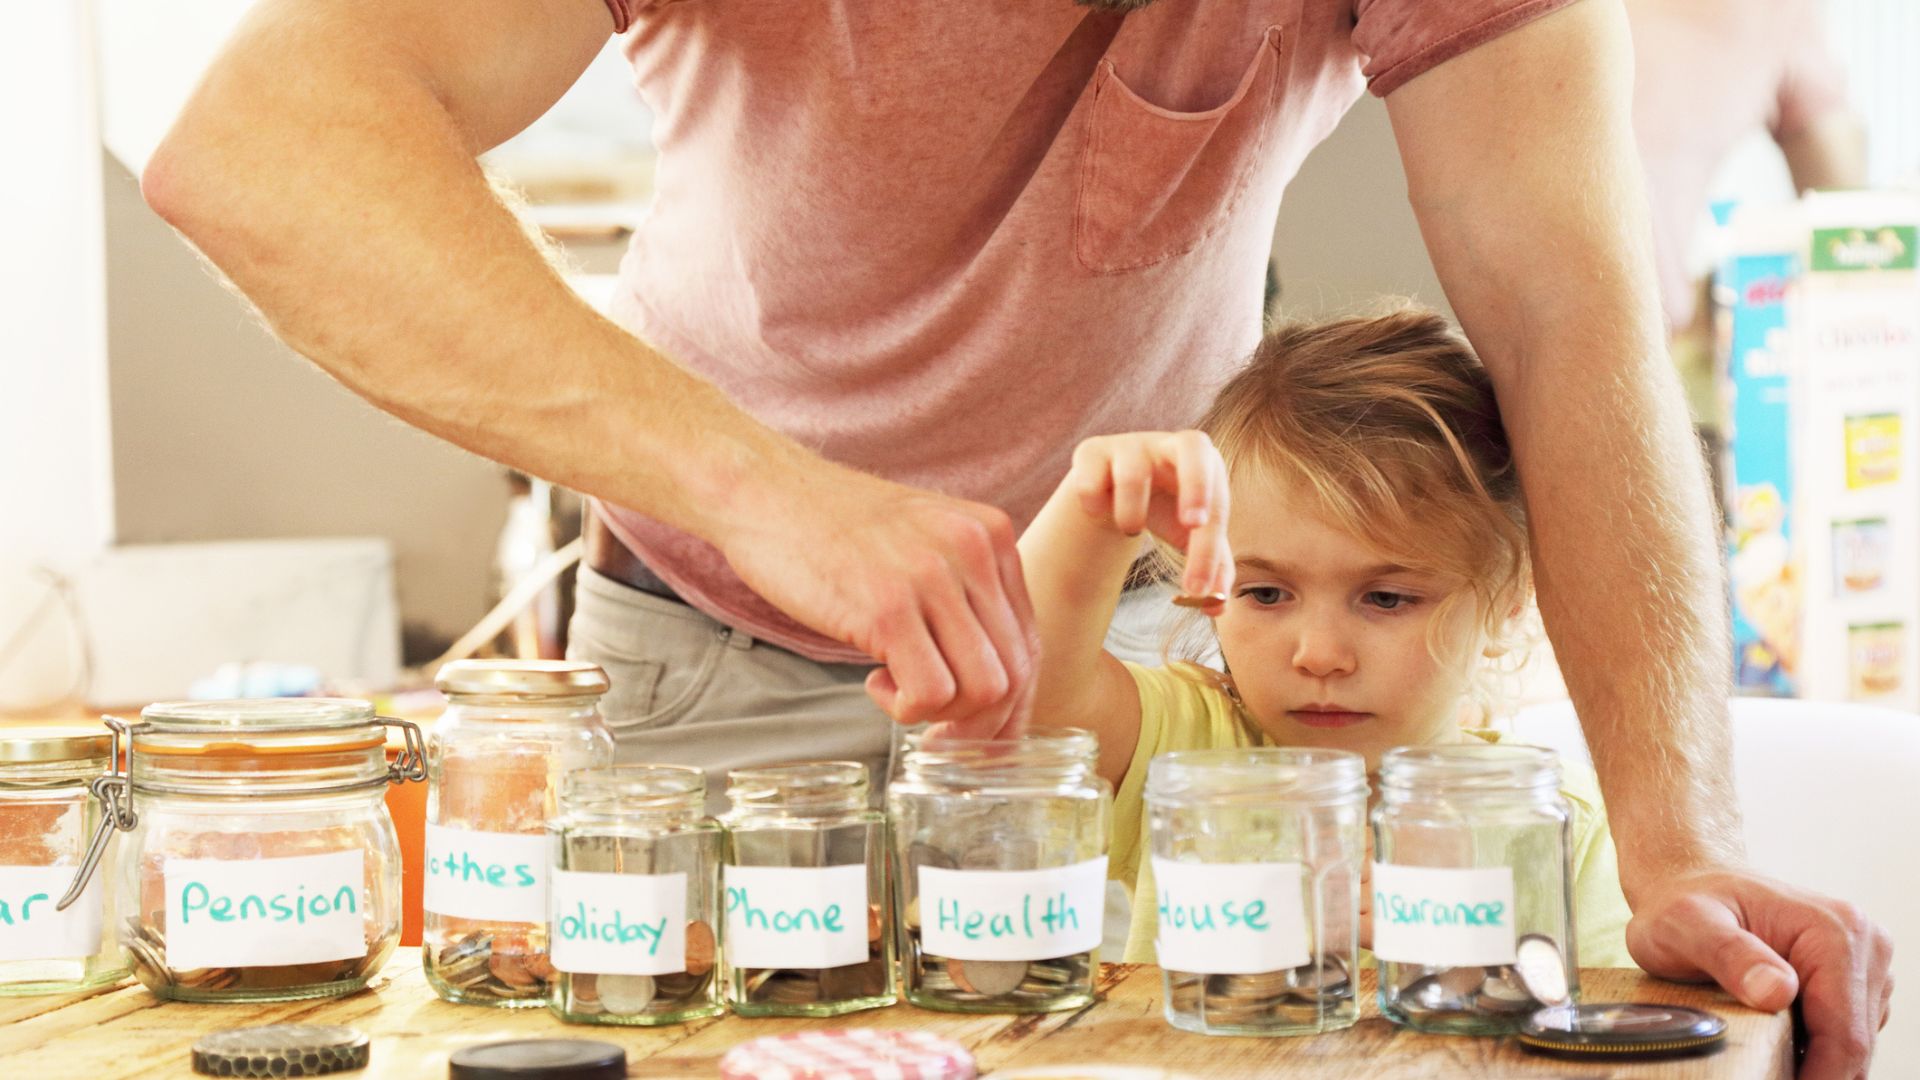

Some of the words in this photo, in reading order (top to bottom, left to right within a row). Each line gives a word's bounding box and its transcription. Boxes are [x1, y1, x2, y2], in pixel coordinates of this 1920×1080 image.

[181, 881, 356, 925] Pension
[938, 892, 1079, 940] Health
[557, 901, 667, 957] oliday
